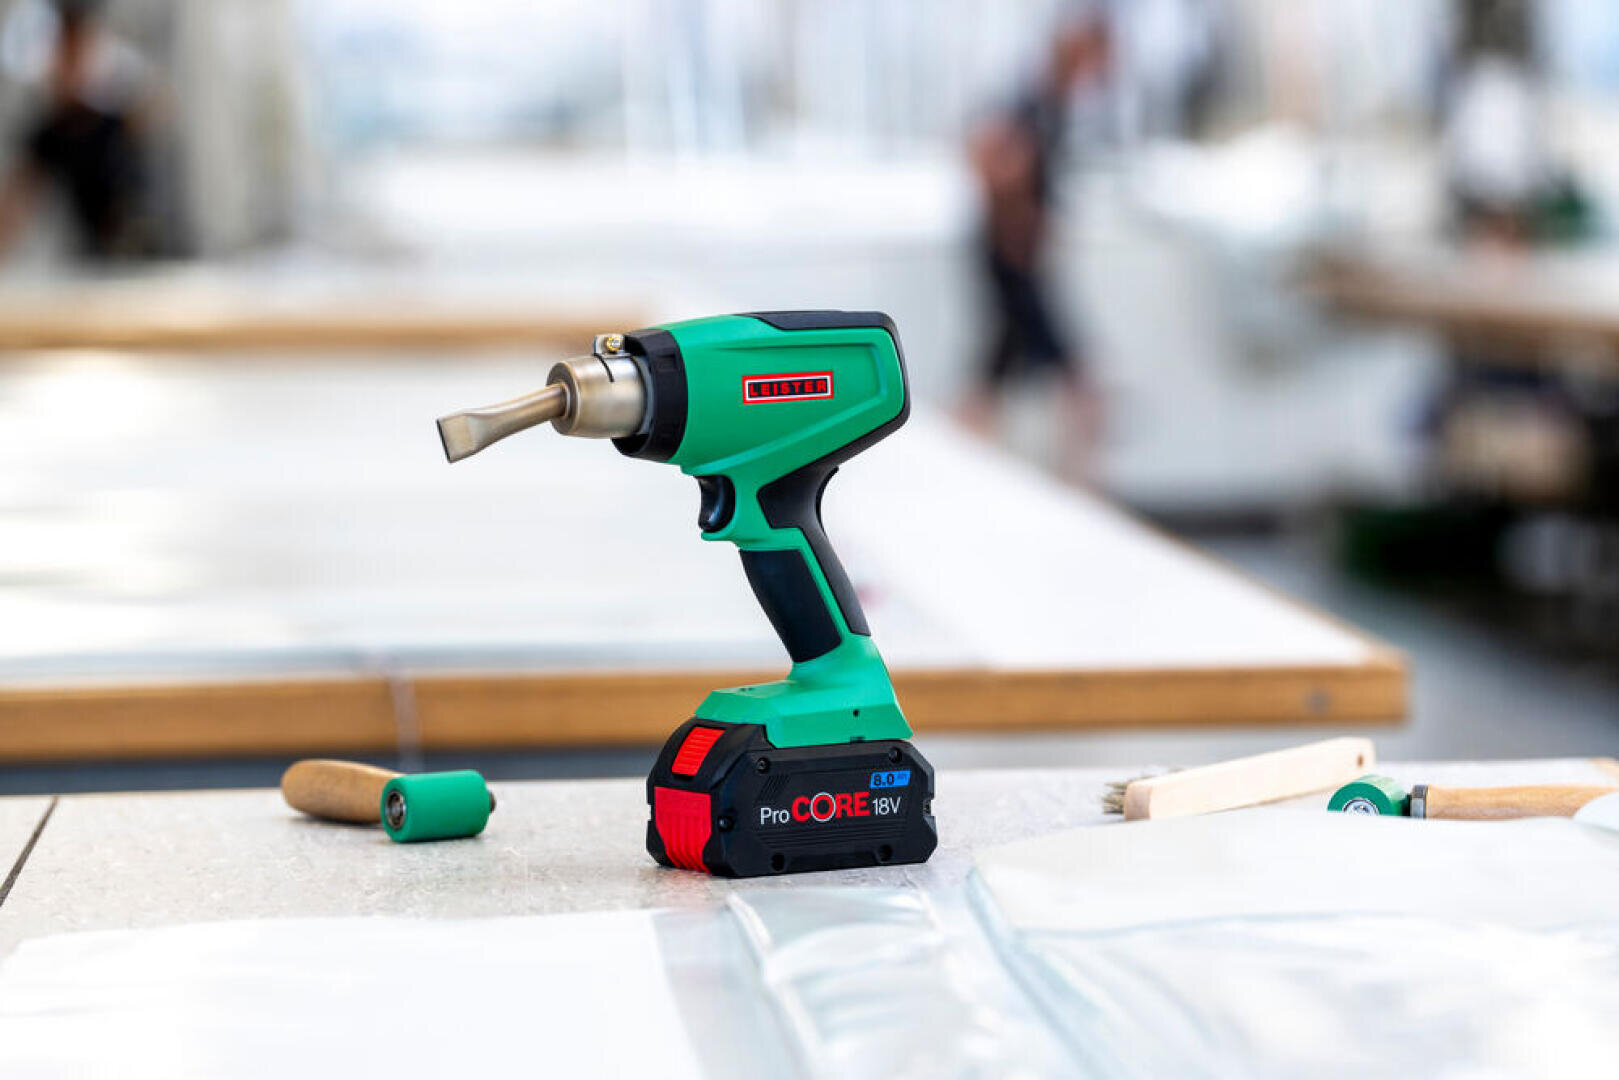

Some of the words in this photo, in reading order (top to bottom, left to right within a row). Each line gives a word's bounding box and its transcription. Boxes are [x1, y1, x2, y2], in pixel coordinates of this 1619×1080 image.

[749, 380, 827, 396] LEISTER
[873, 773, 895, 786] 8.0
[872, 796, 902, 816] 18V
